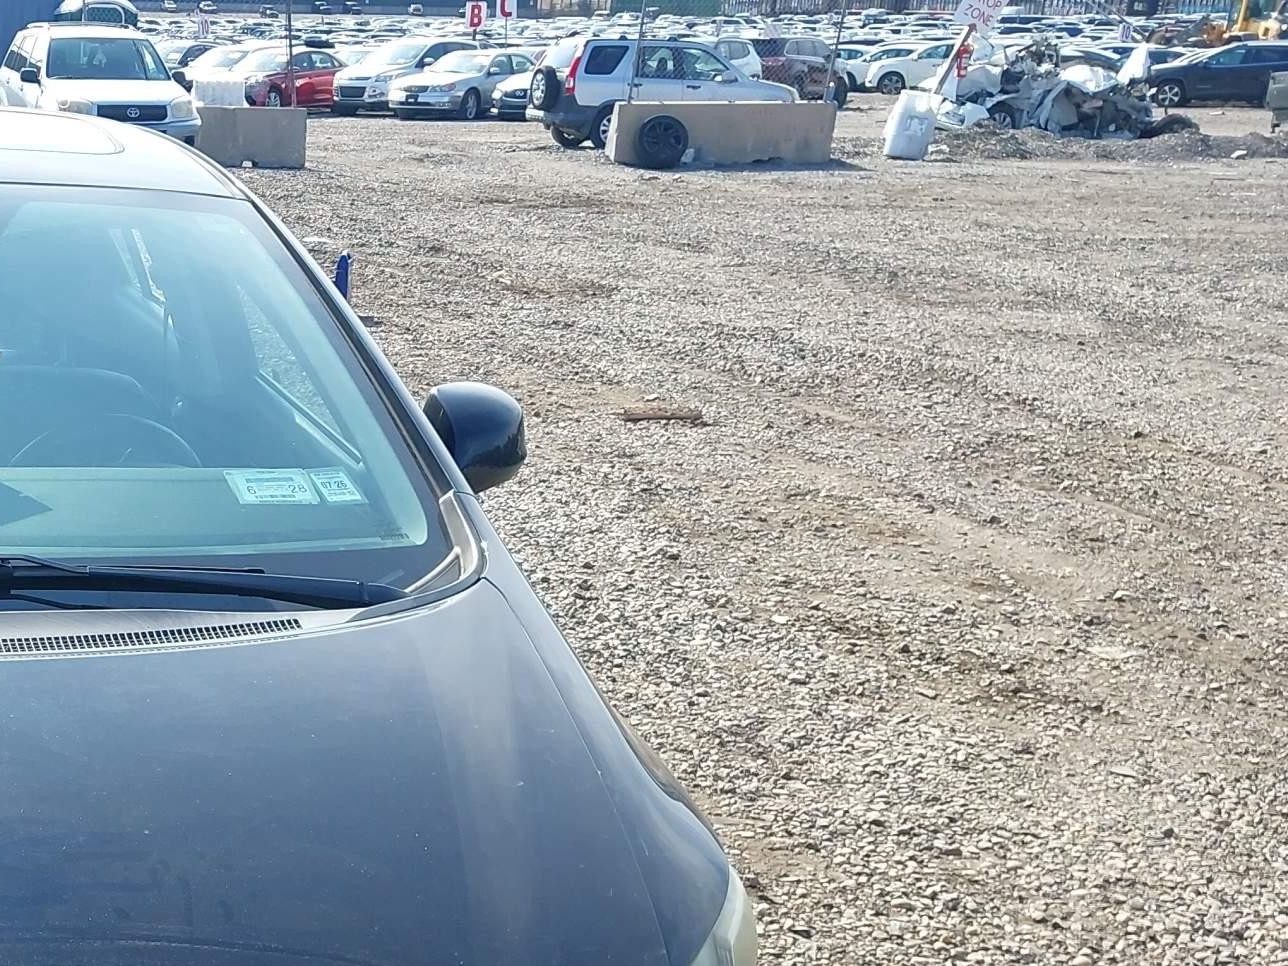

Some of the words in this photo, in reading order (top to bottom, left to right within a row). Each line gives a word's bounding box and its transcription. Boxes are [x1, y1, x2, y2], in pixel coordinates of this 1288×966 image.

[470, 4, 482, 28] B
[964, 3, 994, 27] ZONE
[1122, 24, 1131, 40] 10
